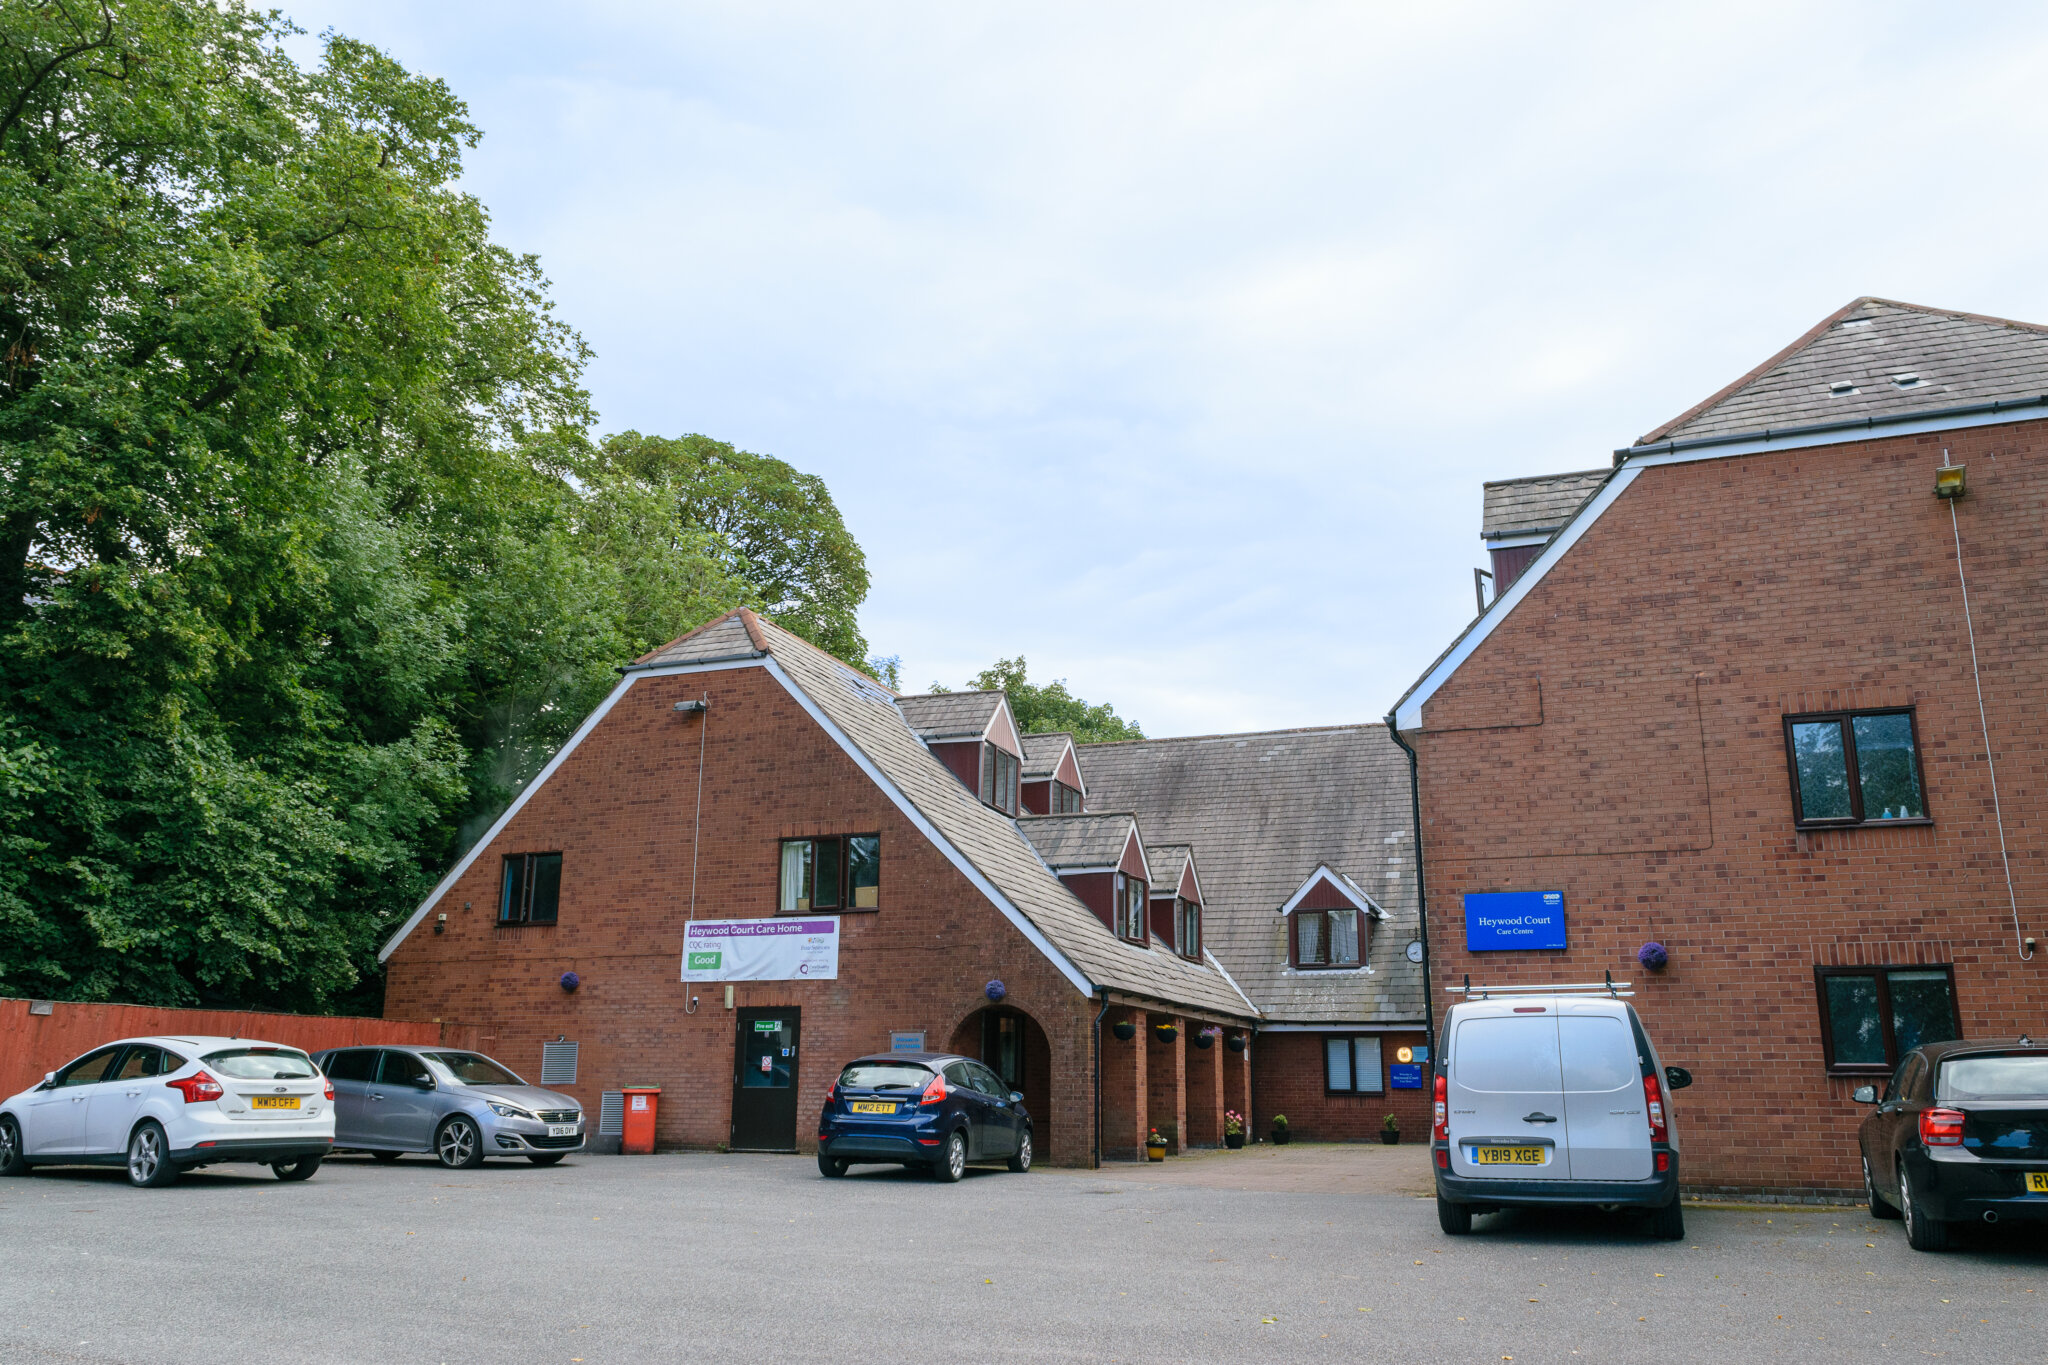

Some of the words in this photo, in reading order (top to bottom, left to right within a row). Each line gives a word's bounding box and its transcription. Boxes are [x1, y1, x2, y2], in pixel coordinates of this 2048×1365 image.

[1478, 916, 1522, 928] Heywood
[1524, 916, 1551, 925] Court
[690, 926, 729, 937] Heywood
[730, 925, 754, 935] Court
[756, 925, 776, 934] Care
[777, 924, 803, 933] Home
[1512, 927, 1534, 935] Centre
[688, 941, 702, 949] CQC
[703, 940, 721, 949] rating
[694, 954, 716, 965] Good
[278, 1097, 295, 1107] CFF
[875, 1103, 892, 1112] ETT
[1482, 1149, 1511, 1162] YB19
[1514, 1149, 1541, 1162] XGE
